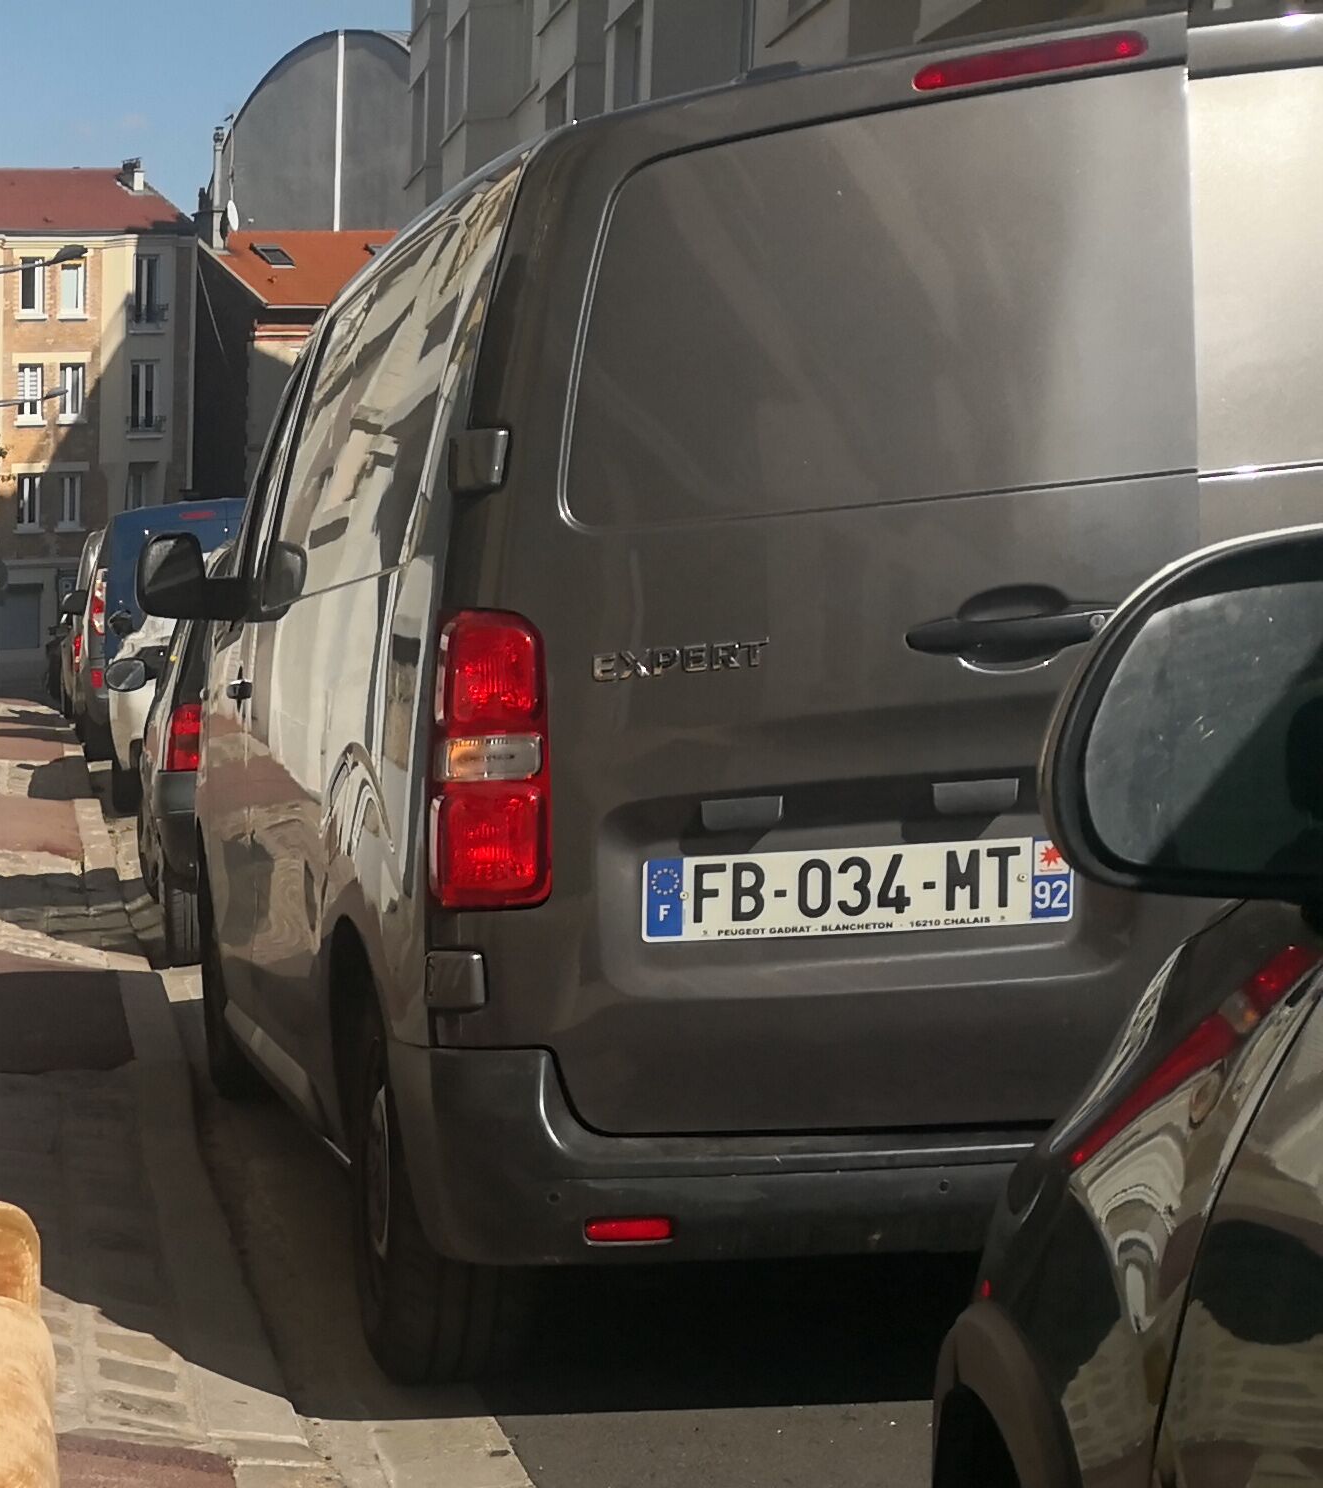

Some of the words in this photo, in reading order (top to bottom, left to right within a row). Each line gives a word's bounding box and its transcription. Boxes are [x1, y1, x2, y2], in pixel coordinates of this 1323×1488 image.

[593, 636, 770, 682] EXPERT
[693, 846, 1021, 923] FB-034-MT
[1034, 880, 1068, 909] 92
[659, 904, 670, 922] F
[717, 927, 765, 936] PEUGEOT
[769, 925, 811, 934] GADRAT
[821, 922, 894, 932] BLANCHETON
[909, 919, 941, 928] 16210
[943, 916, 991, 926] CHALAIS
